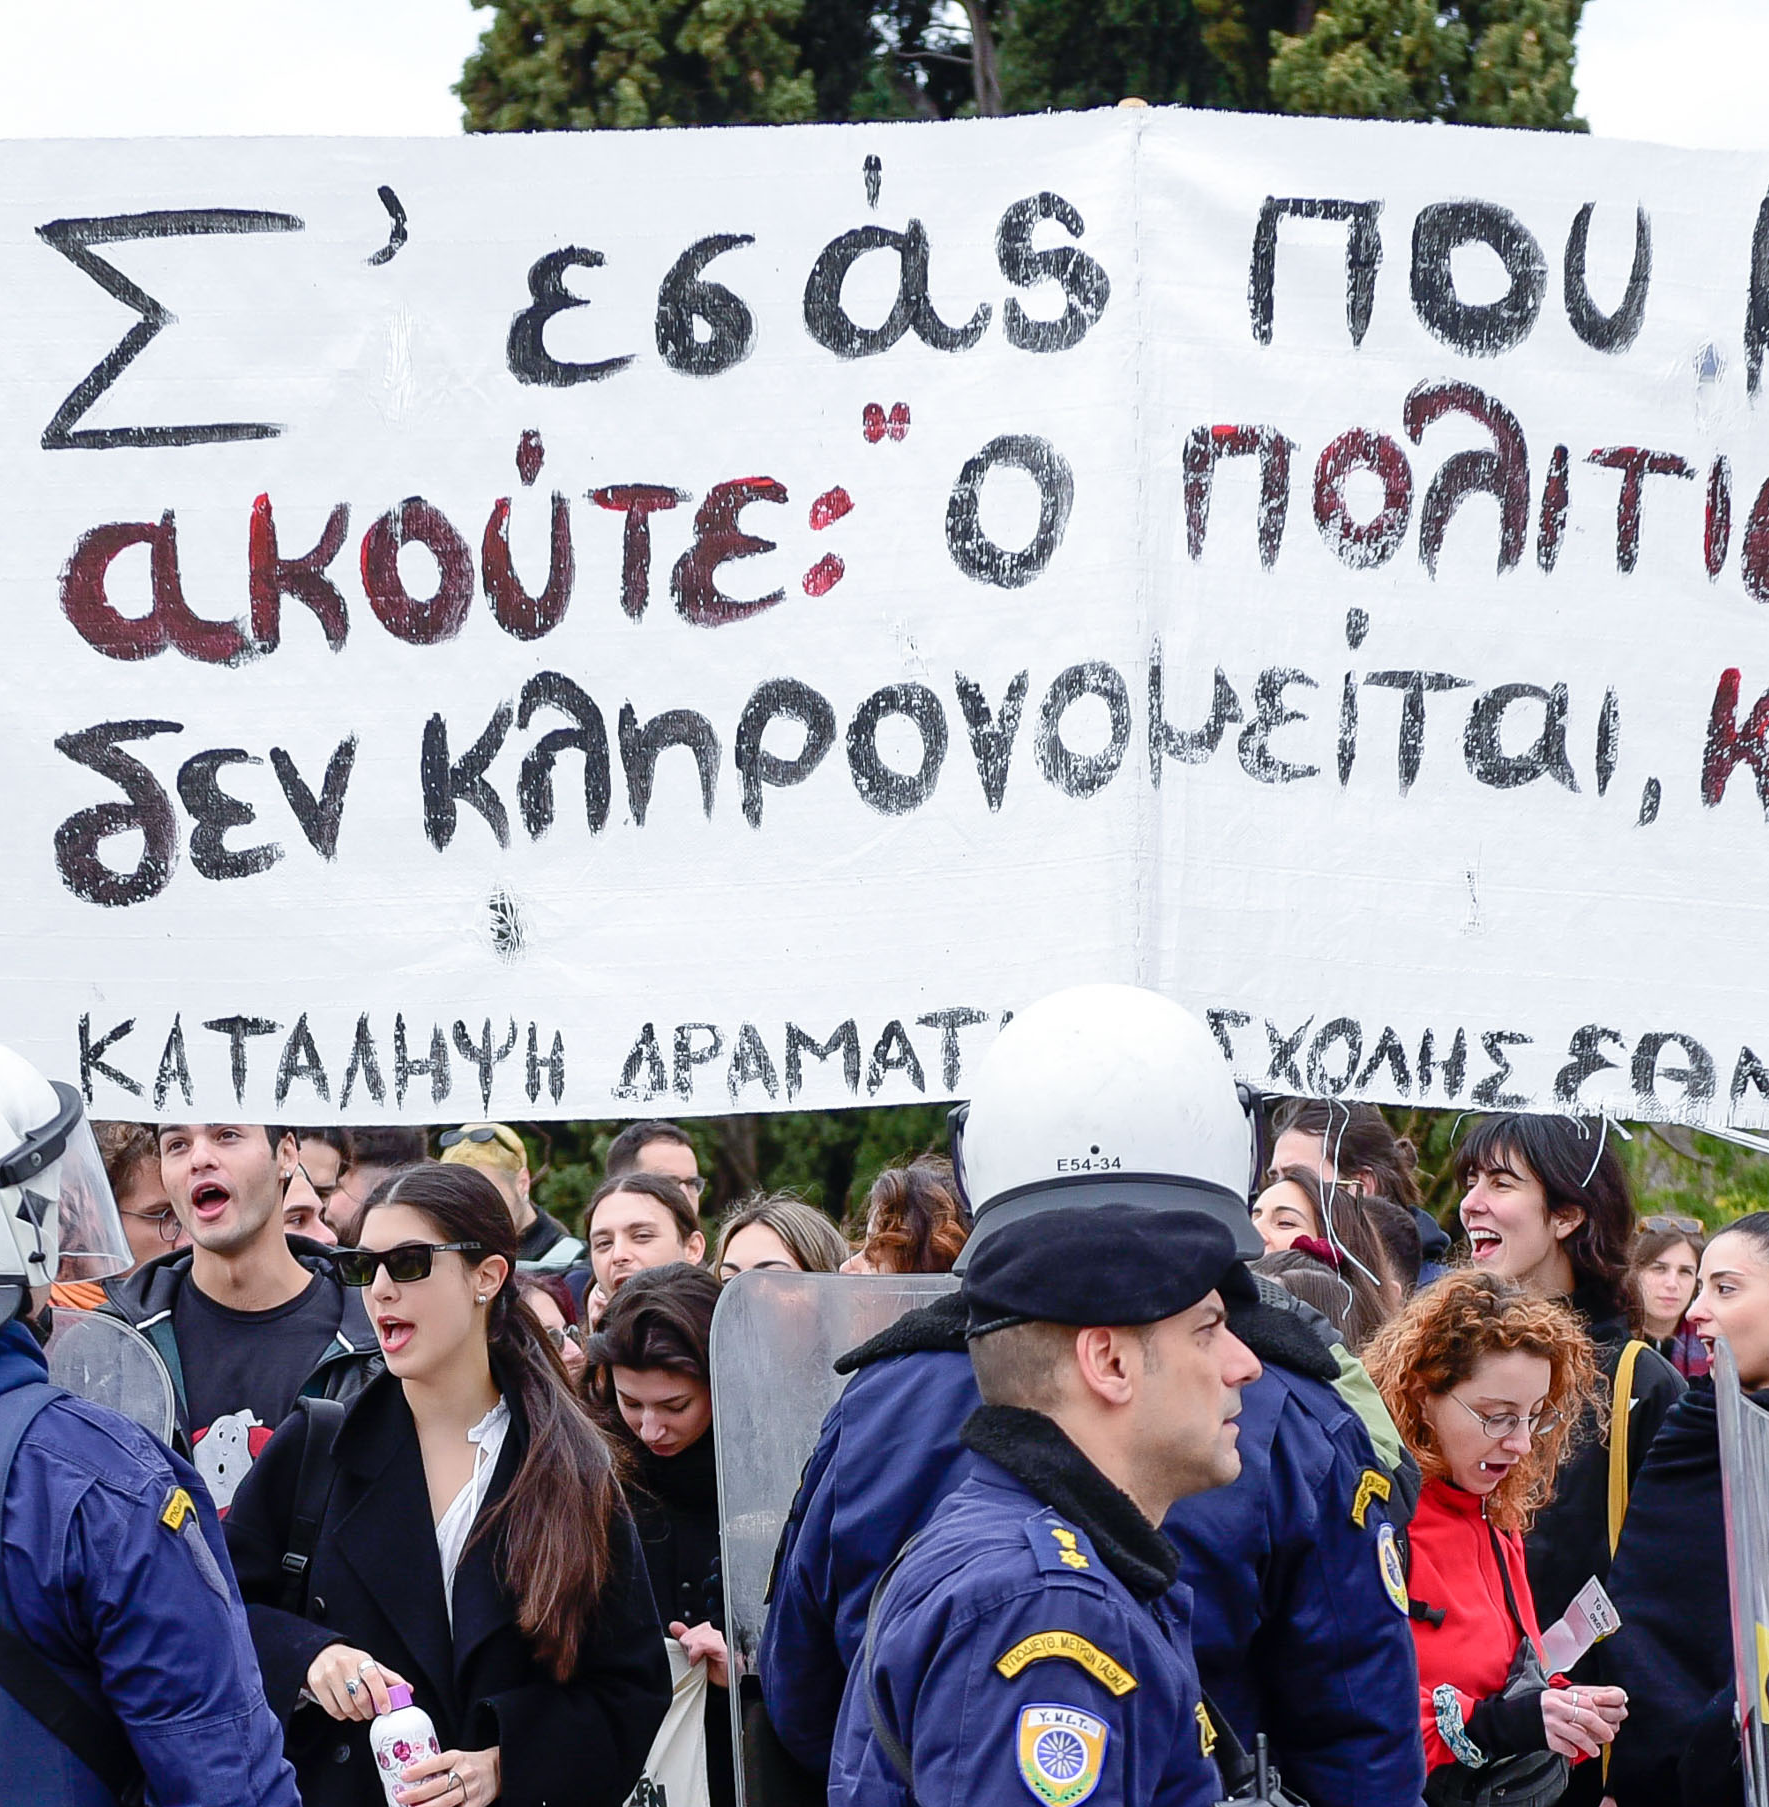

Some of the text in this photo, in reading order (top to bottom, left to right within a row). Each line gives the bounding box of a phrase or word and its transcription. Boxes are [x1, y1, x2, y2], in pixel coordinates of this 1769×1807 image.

[59, 428, 855, 665] ακούτε:
[54, 718, 360, 907] δεν
[77, 1012, 567, 1111] ΚΑΤΑΛΗΨΗ
[1056, 1157, 1122, 1172] E54-34
